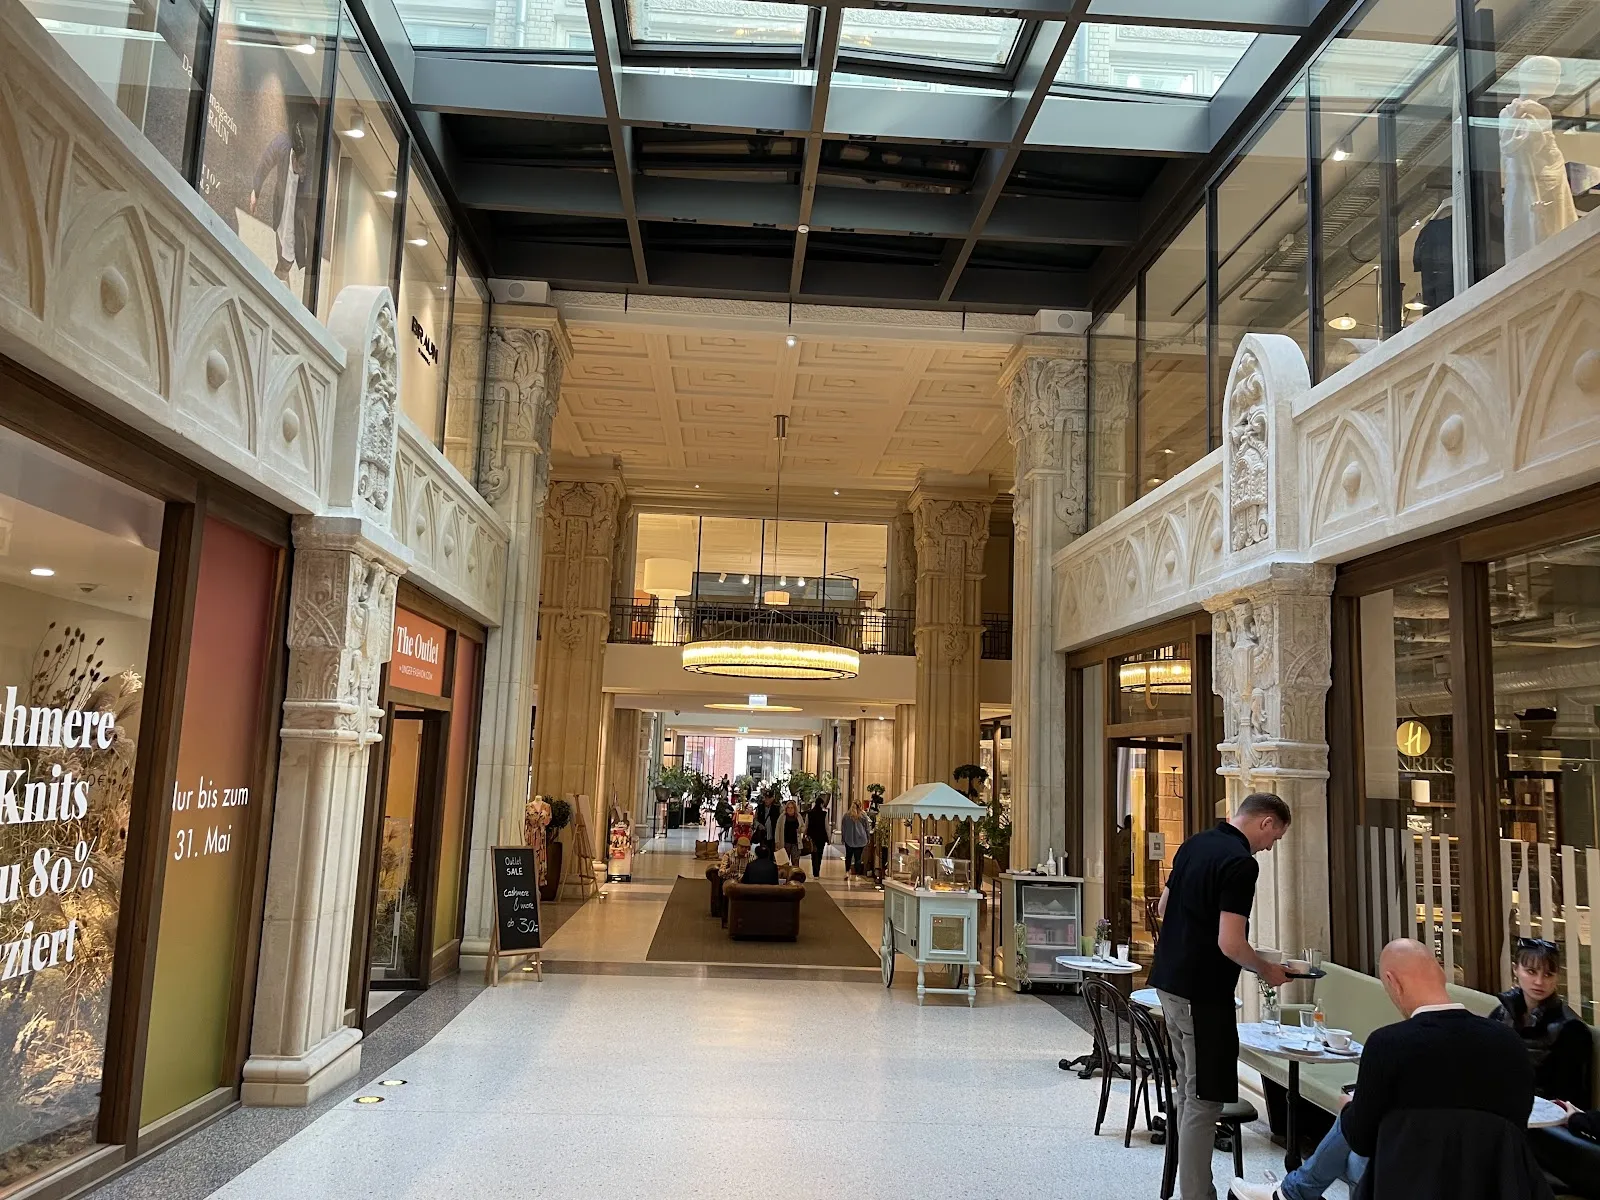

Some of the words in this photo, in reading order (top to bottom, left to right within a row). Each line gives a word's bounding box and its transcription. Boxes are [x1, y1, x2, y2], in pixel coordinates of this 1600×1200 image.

[207, 109, 229, 145] RAUN
[412, 315, 438, 364] BRAUN
[397, 626, 414, 656] The
[414, 633, 439, 664] Outlet
[0, 686, 115, 749] hmere
[0, 764, 90, 824] Knits
[198, 775, 218, 809] bis
[222, 787, 249, 807] zum
[174, 828, 198, 860] 31.
[204, 824, 232, 856] Mai
[29, 836, 97, 898] 80%
[505, 857, 521, 866] Outlet
[506, 867, 523, 876] SALE
[520, 902, 534, 910] more
[0, 918, 78, 981] ziert
